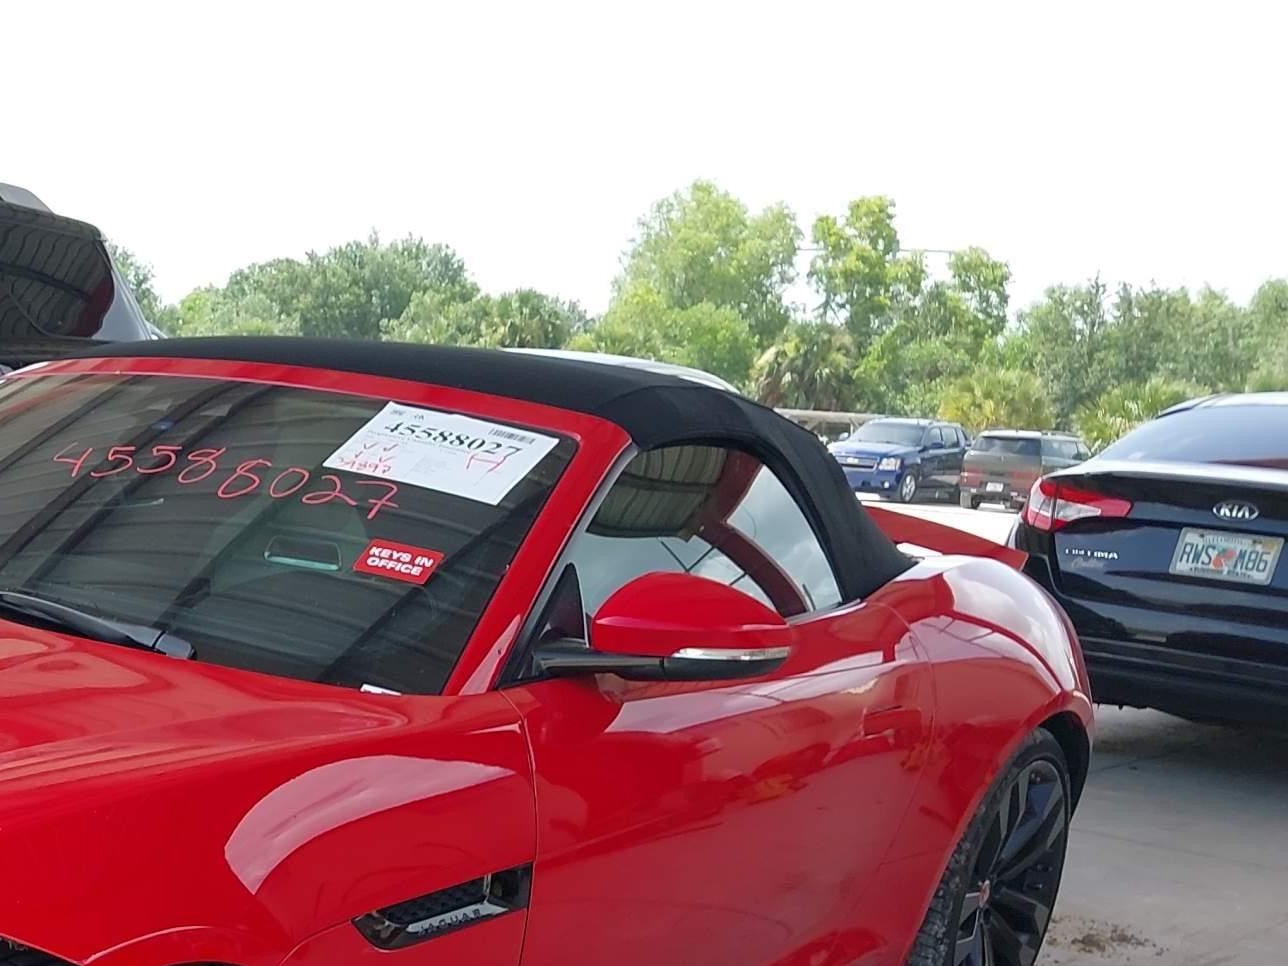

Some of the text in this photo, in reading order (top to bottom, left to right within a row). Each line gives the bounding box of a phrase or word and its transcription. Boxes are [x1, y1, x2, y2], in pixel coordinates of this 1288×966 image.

[384, 421, 523, 458] 45588027
[53, 442, 399, 520] 45588027
[1219, 503, 1250, 520] KIA
[366, 557, 424, 577] OFFICE
[368, 546, 434, 568] KEYS IN
[418, 907, 481, 937] JAGUAR
